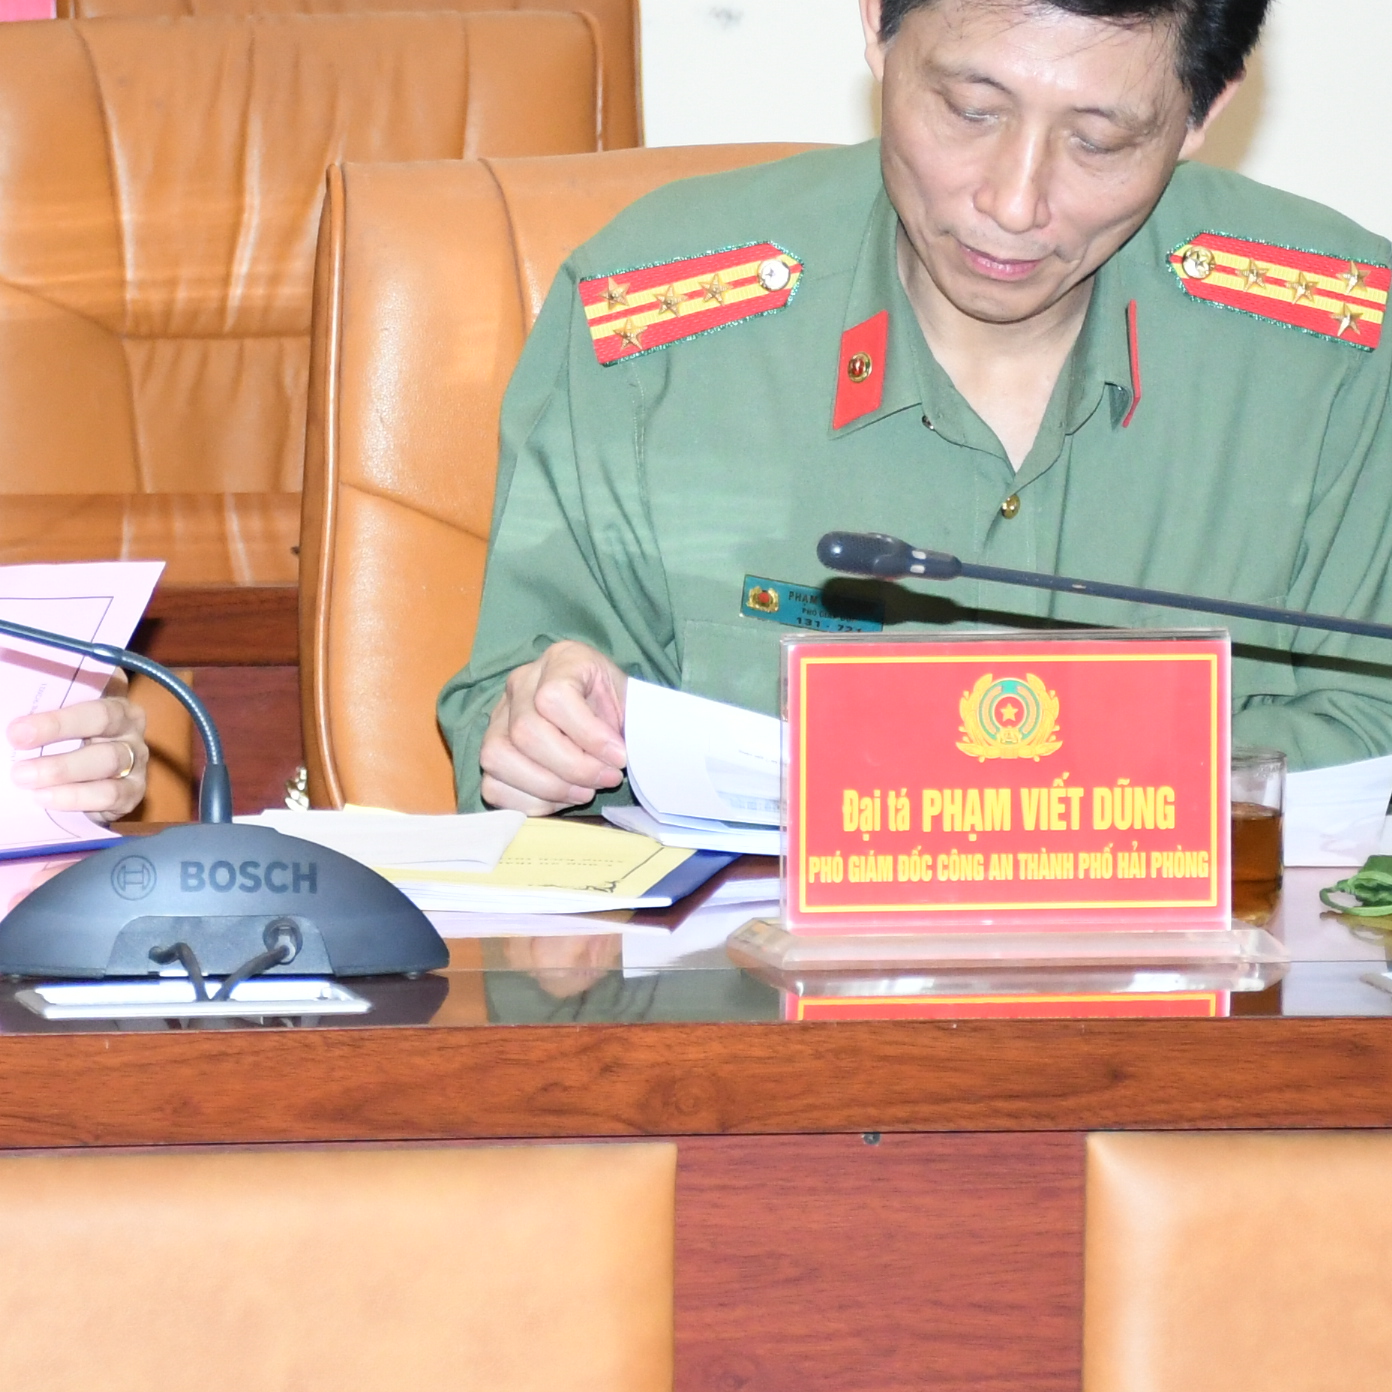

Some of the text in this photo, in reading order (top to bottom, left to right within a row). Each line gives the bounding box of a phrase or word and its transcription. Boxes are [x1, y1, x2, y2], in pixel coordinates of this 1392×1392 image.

[842, 771, 1175, 842] Đại tá PHẠM VIẾT DŨNG
[179, 860, 318, 895] BOSCH
[808, 840, 1210, 883] PHÓ GIÁM ĐỐC CÔNG AN THÀNH PHỐ HẢI PHÒNG
